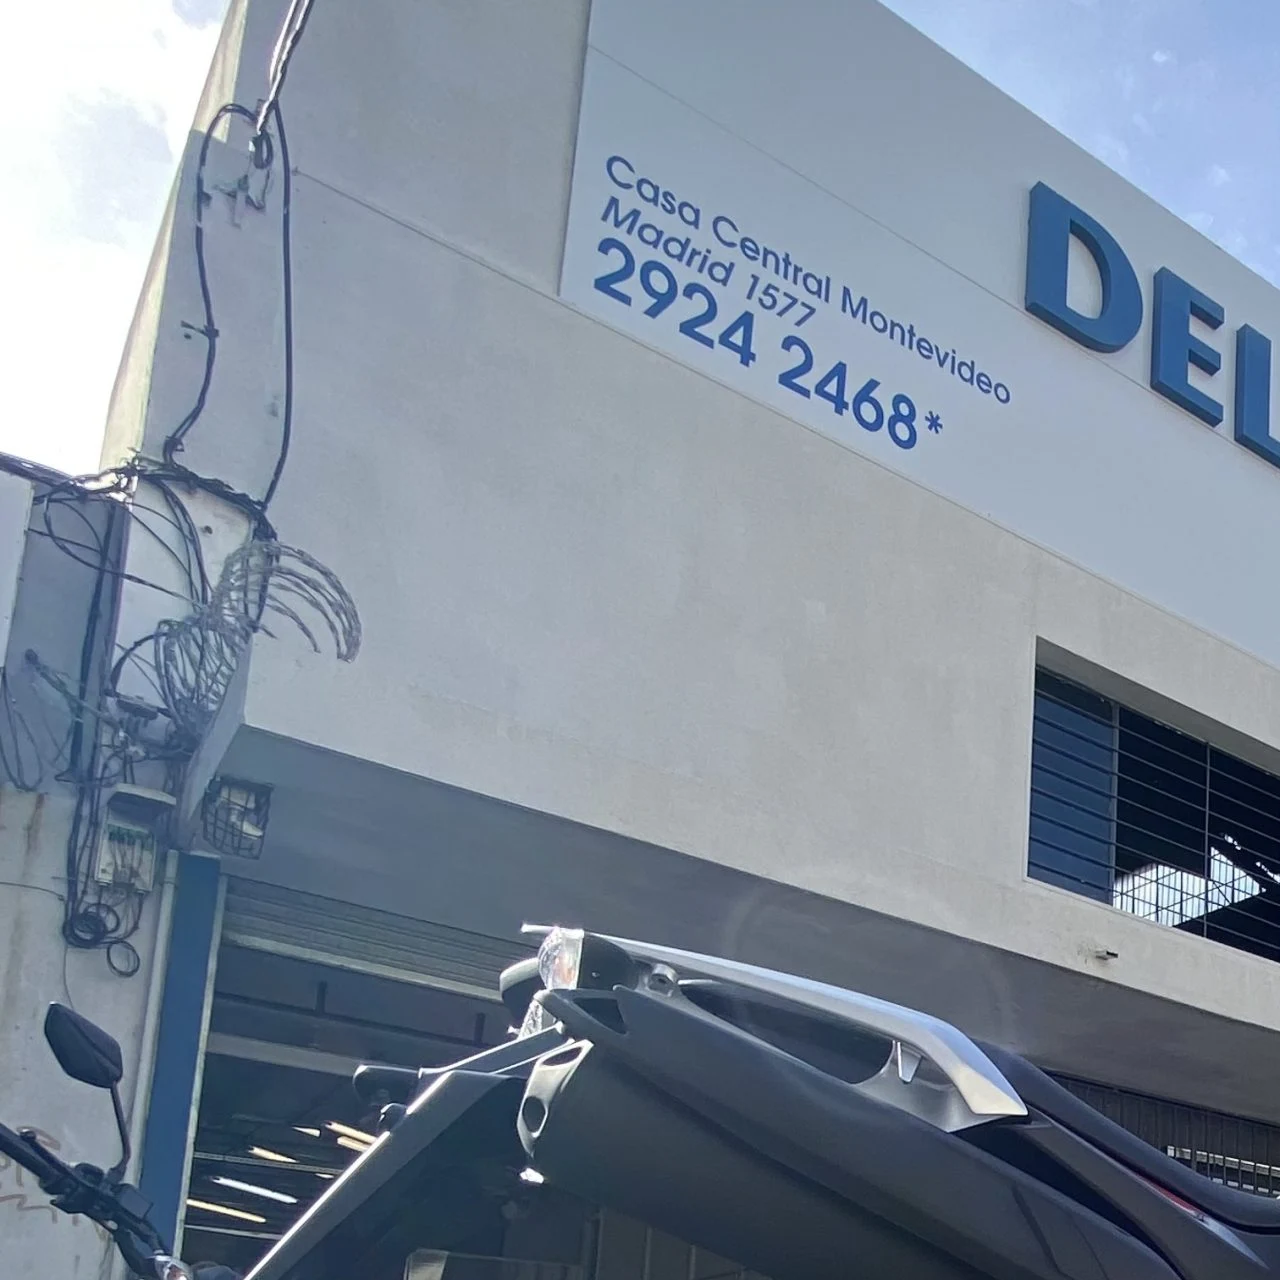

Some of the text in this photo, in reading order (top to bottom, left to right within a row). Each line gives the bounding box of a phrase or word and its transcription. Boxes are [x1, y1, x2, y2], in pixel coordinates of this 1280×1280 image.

[593, 237, 756, 368] 2924
[600, 196, 816, 327] Madrid 1577
[605, 155, 1011, 404] Casa Central Montevideo
